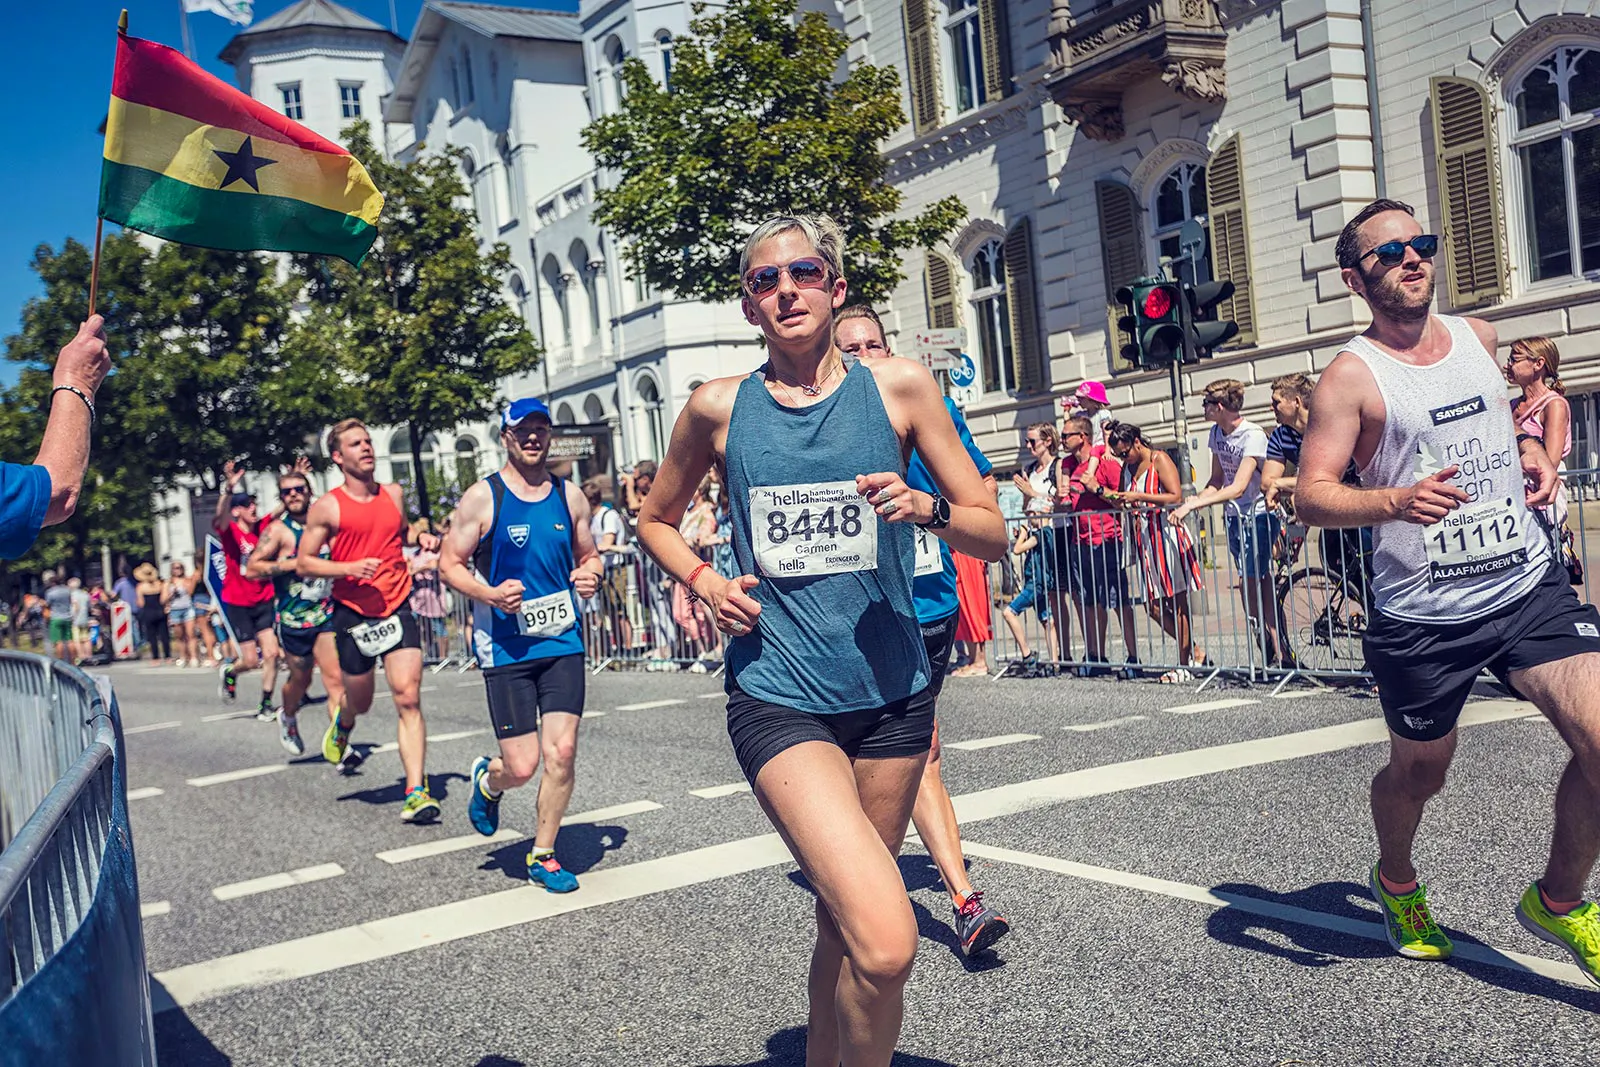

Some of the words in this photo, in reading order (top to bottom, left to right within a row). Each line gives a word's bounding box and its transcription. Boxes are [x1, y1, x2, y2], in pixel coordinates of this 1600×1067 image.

[1435, 400, 1480, 421] SAYSKY
[1446, 437, 1483, 461] run
[1451, 445, 1512, 480] squad
[772, 490, 809, 506] hella
[809, 488, 844, 497] hamburg
[1456, 478, 1493, 504] gn
[767, 504, 862, 544] 8448
[1443, 513, 1474, 528] hella
[918, 534, 929, 555] 1
[1433, 514, 1519, 554] 11112
[795, 543, 837, 554] Carmen
[1466, 550, 1498, 562] Dennis
[779, 559, 805, 571] hella
[825, 556, 853, 564] ERDINGER
[1433, 556, 1512, 579] ALAAFMYCREW
[524, 603, 568, 628] 9975
[362, 623, 396, 643] 4369
